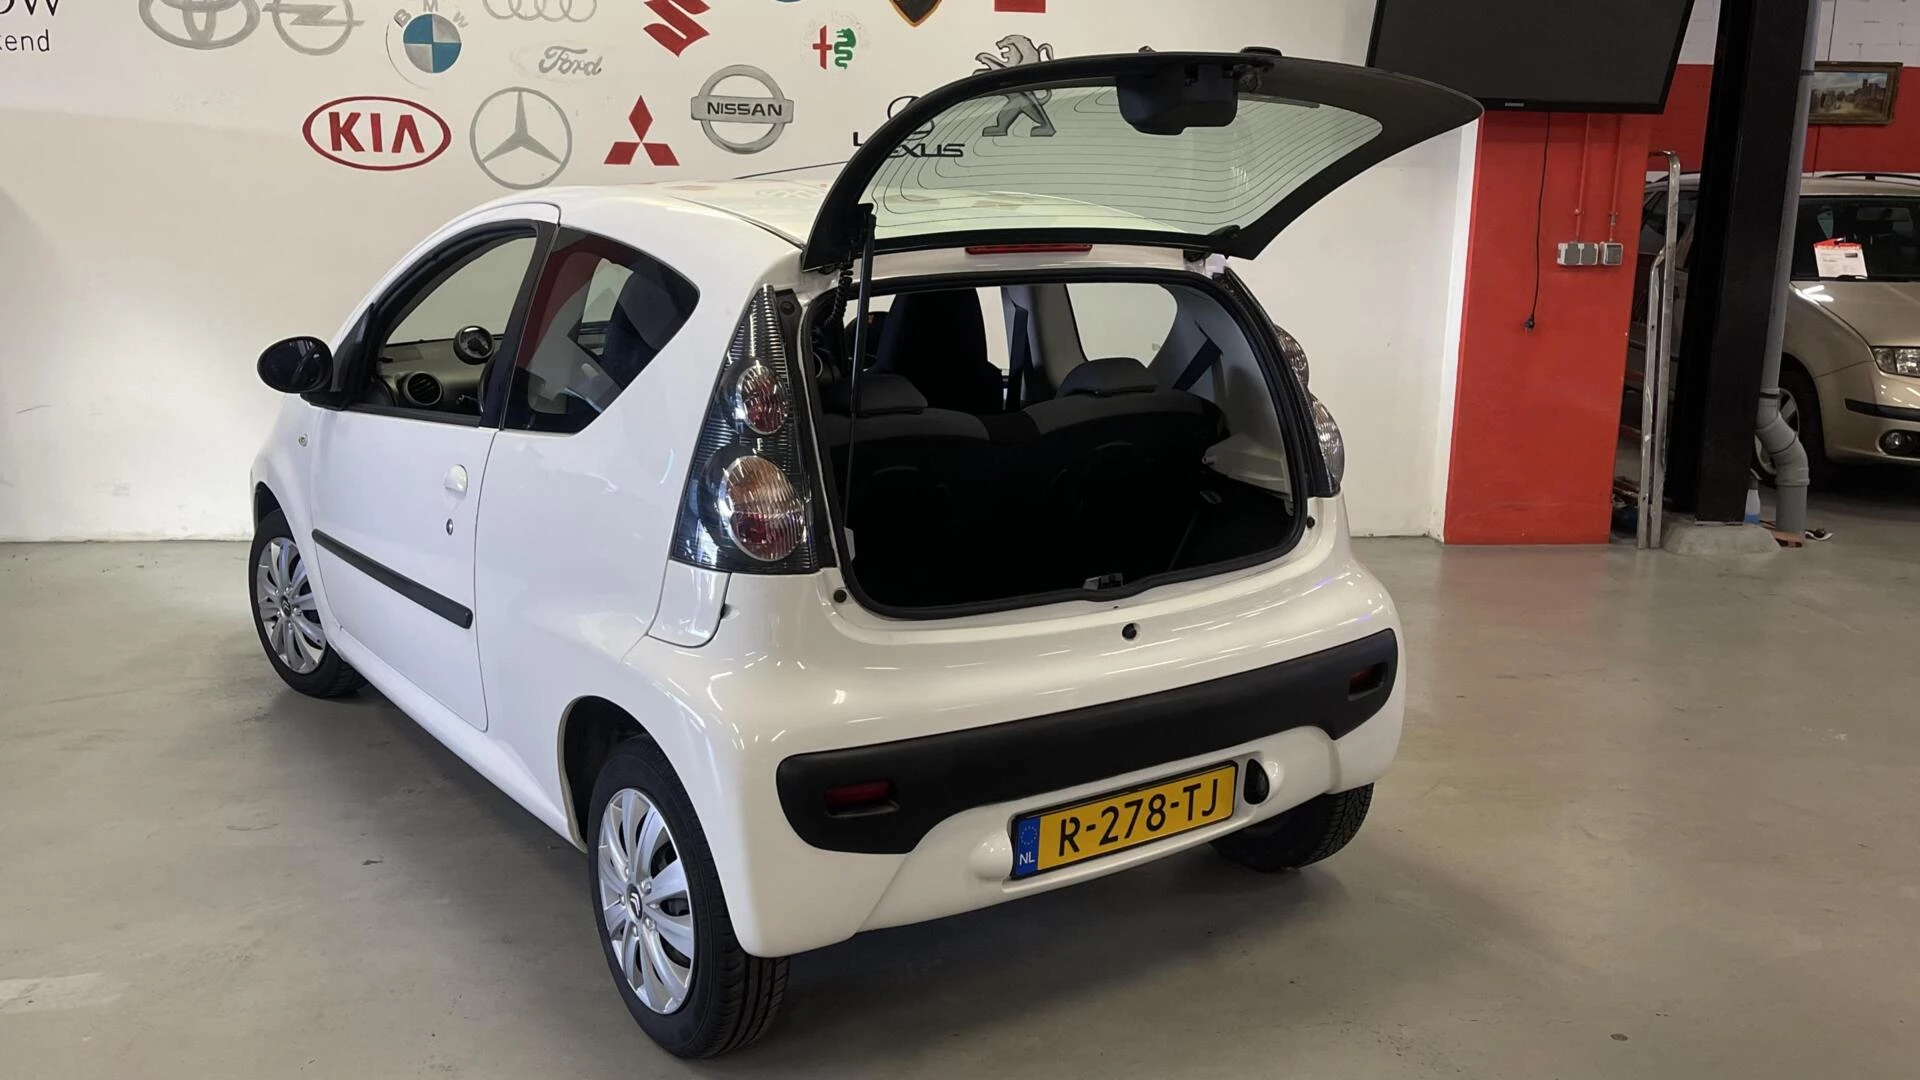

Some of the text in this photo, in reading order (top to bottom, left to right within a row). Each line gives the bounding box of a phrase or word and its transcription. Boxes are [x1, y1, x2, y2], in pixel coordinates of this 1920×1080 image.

[0, 28, 50, 52] end
[538, 45, 602, 76] Ford
[707, 101, 783, 117] NISSAN
[328, 111, 426, 154] KIA
[1058, 778, 1219, 857] R-278-TJ
[1019, 852, 1036, 866] NL
